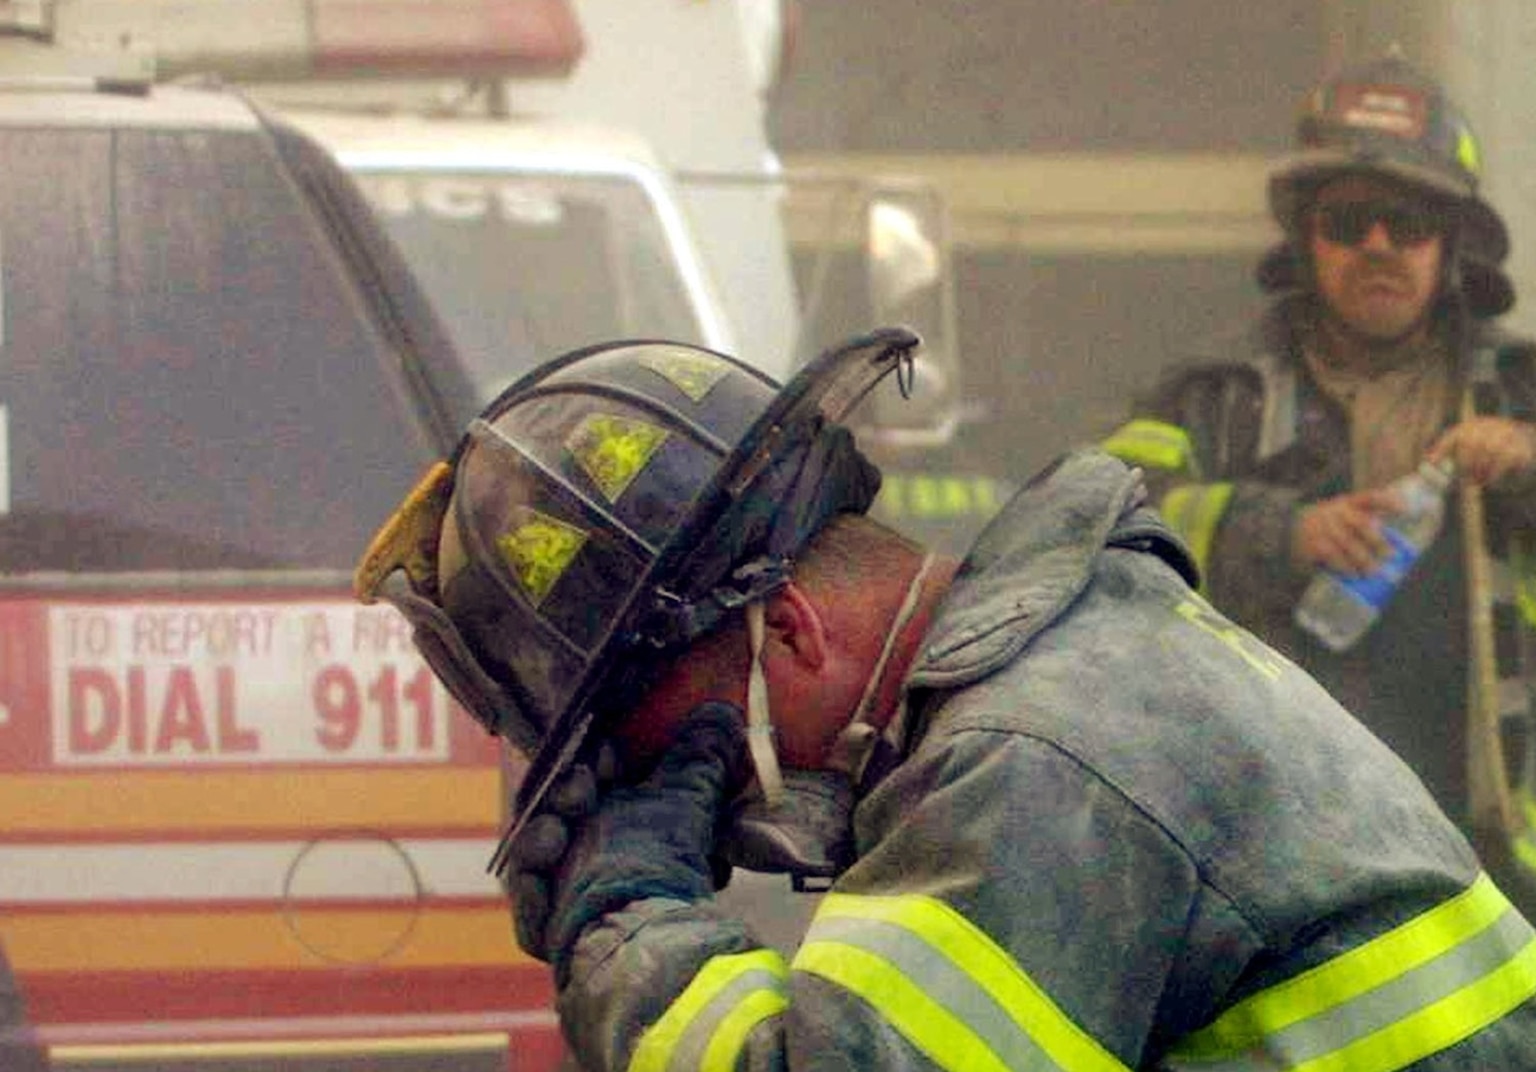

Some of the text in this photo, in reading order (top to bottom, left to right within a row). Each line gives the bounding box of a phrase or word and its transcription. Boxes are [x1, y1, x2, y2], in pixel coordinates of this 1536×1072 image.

[69, 613, 415, 655] TO REPORT A FIR
[69, 662, 434, 753] DIAL 911
